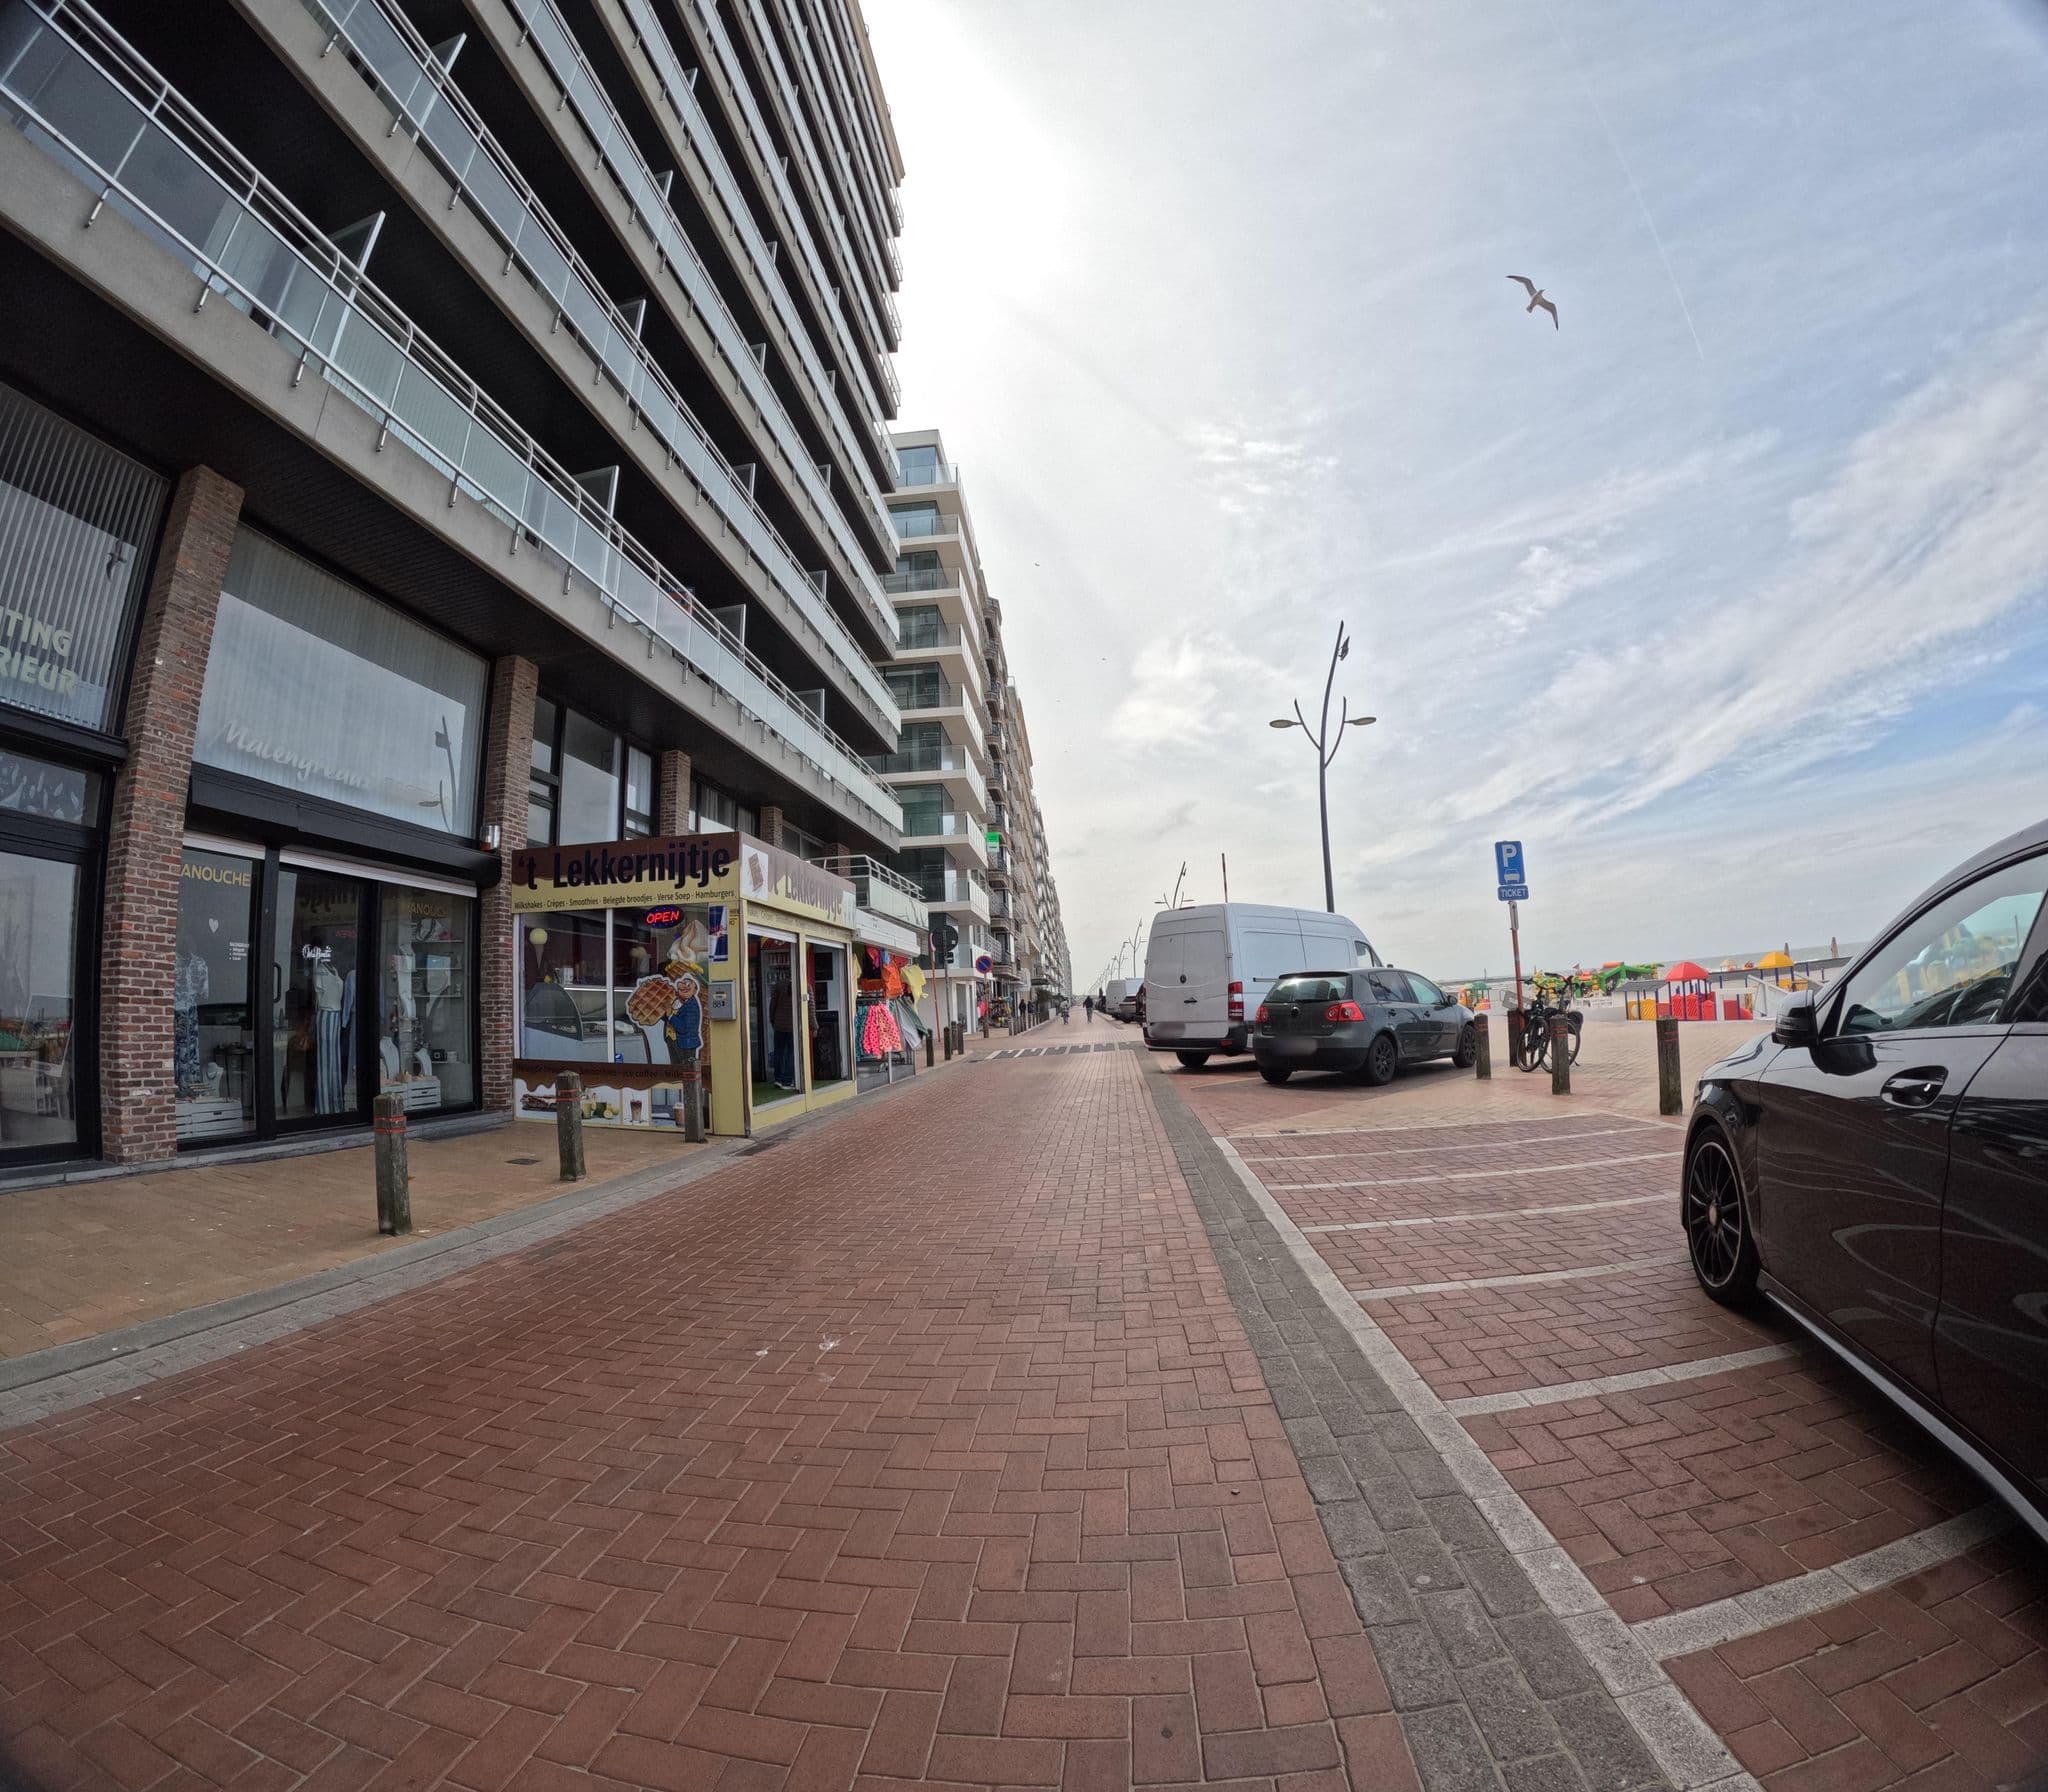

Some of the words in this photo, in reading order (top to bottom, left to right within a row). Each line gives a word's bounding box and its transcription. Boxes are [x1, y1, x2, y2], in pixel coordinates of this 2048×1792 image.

[553, 840, 730, 890] Lekkernijtje
[1502, 844, 1517, 868] P
[181, 863, 252, 887] ANOUCHE
[569, 896, 599, 906] Smoothies
[602, 895, 625, 905] Belegde
[626, 893, 653, 904] broodjes
[657, 892, 674, 901] Verse
[675, 891, 691, 901] Soep
[695, 889, 735, 900] Hamburgers
[1502, 888, 1526, 898] TICKET
[646, 911, 680, 923] OPEN
